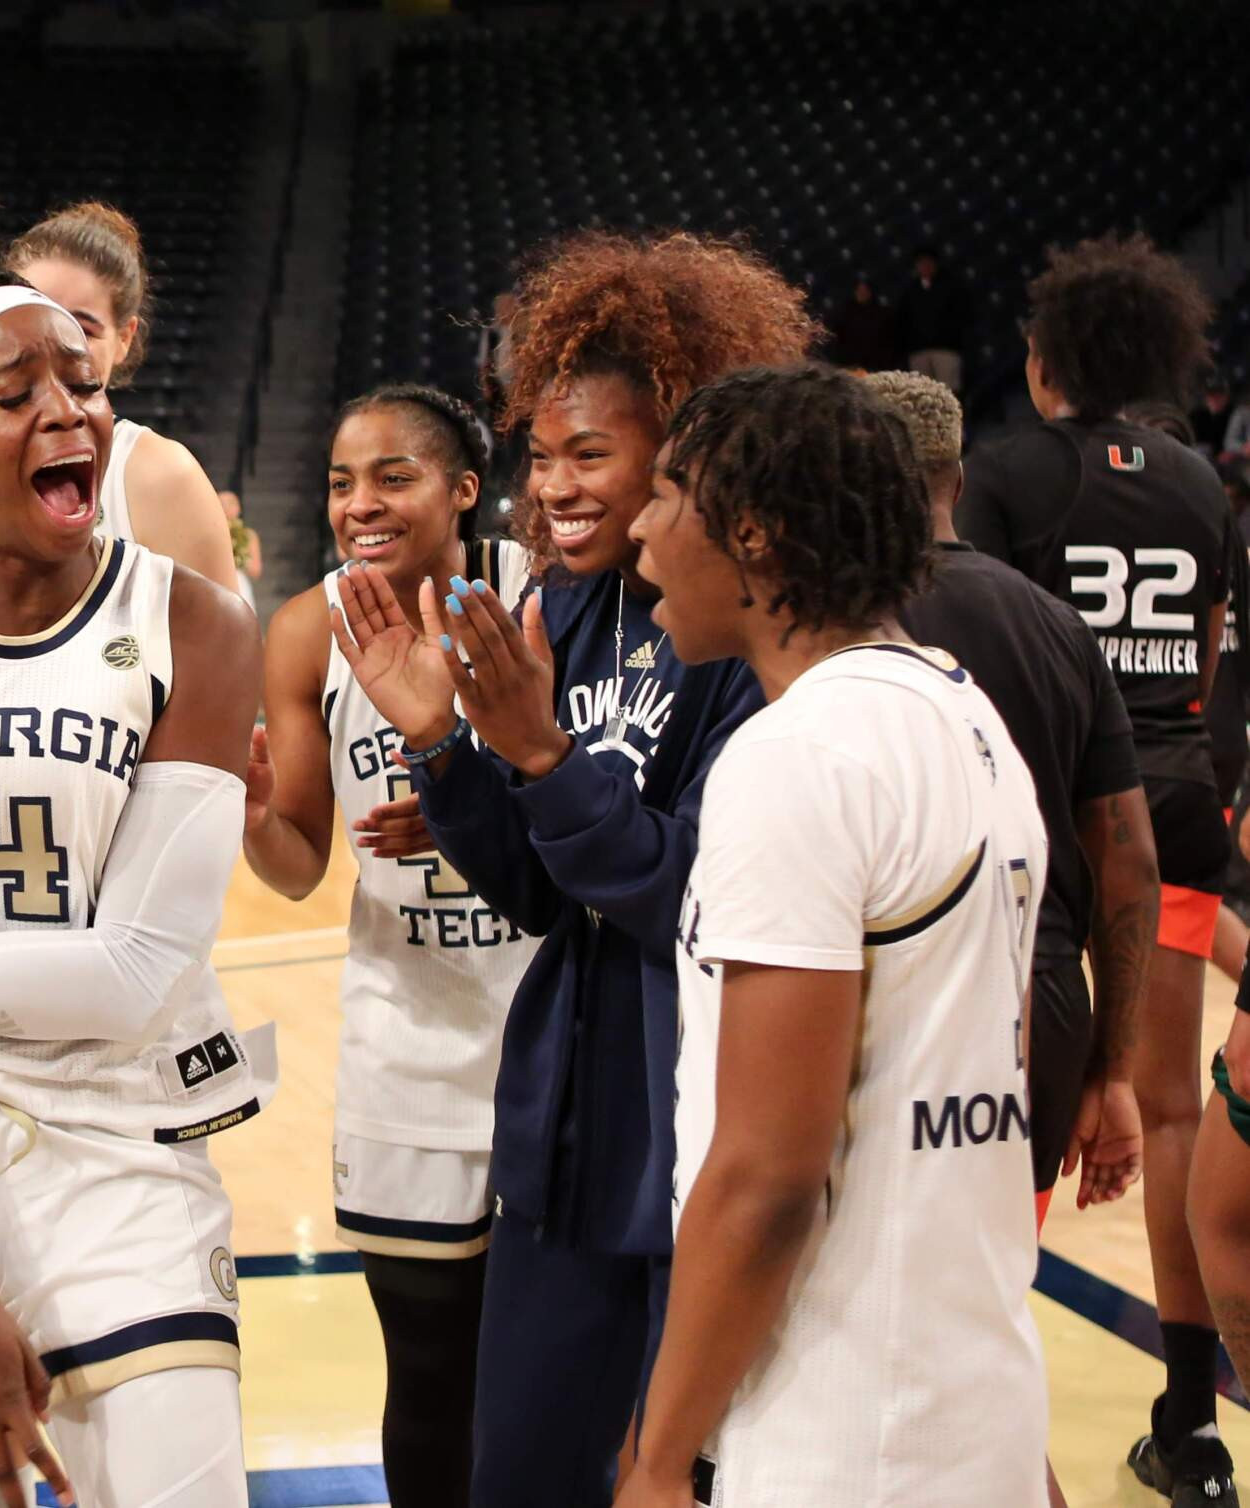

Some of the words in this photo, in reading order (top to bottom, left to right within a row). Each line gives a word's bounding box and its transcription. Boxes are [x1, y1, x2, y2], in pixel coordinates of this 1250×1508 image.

[1106, 444, 1146, 472] U
[1065, 545, 1198, 632] 32
[624, 658, 656, 669] adidas
